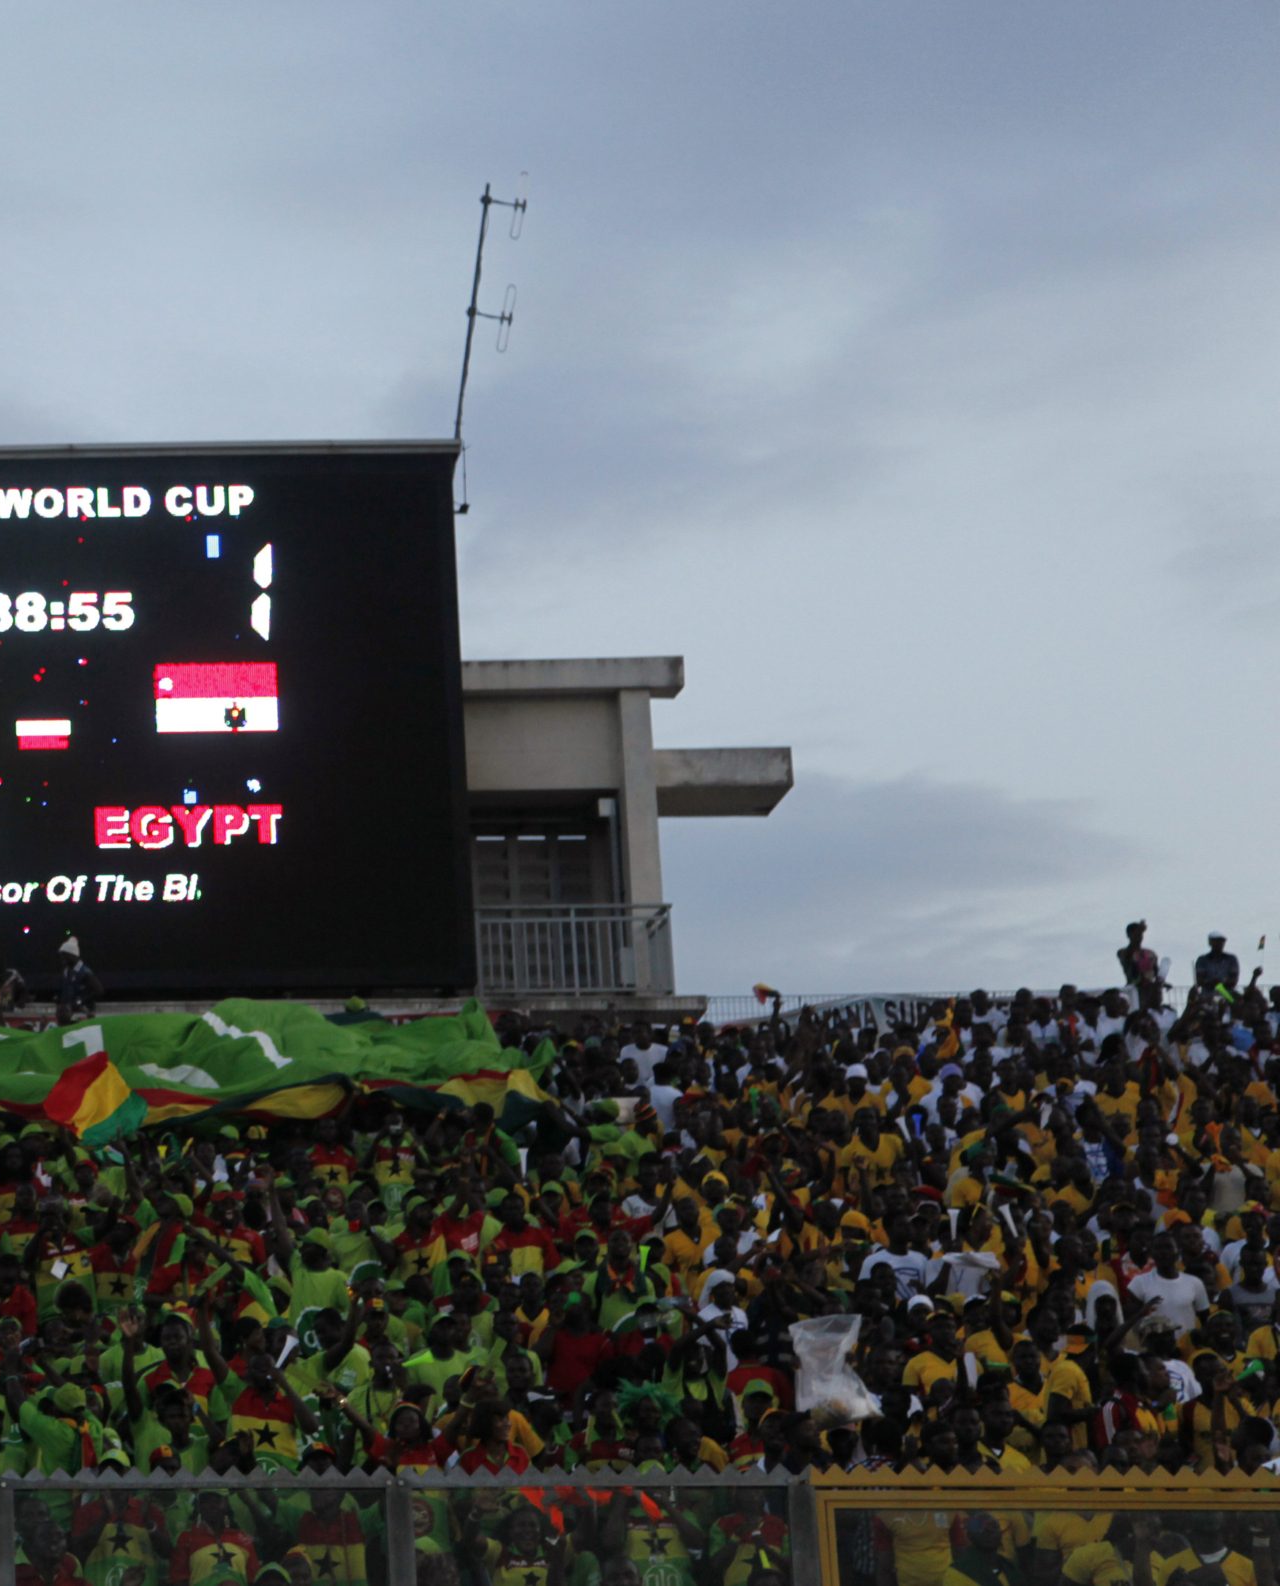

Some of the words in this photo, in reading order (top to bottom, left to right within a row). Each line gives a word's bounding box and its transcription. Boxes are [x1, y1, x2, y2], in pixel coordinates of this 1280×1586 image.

[164, 485, 255, 517] CUP
[250, 542, 273, 641] 1
[94, 804, 283, 849] EGYPT
[46, 874, 87, 903] Of
[95, 874, 154, 902] The
[162, 873, 201, 902] Bl
